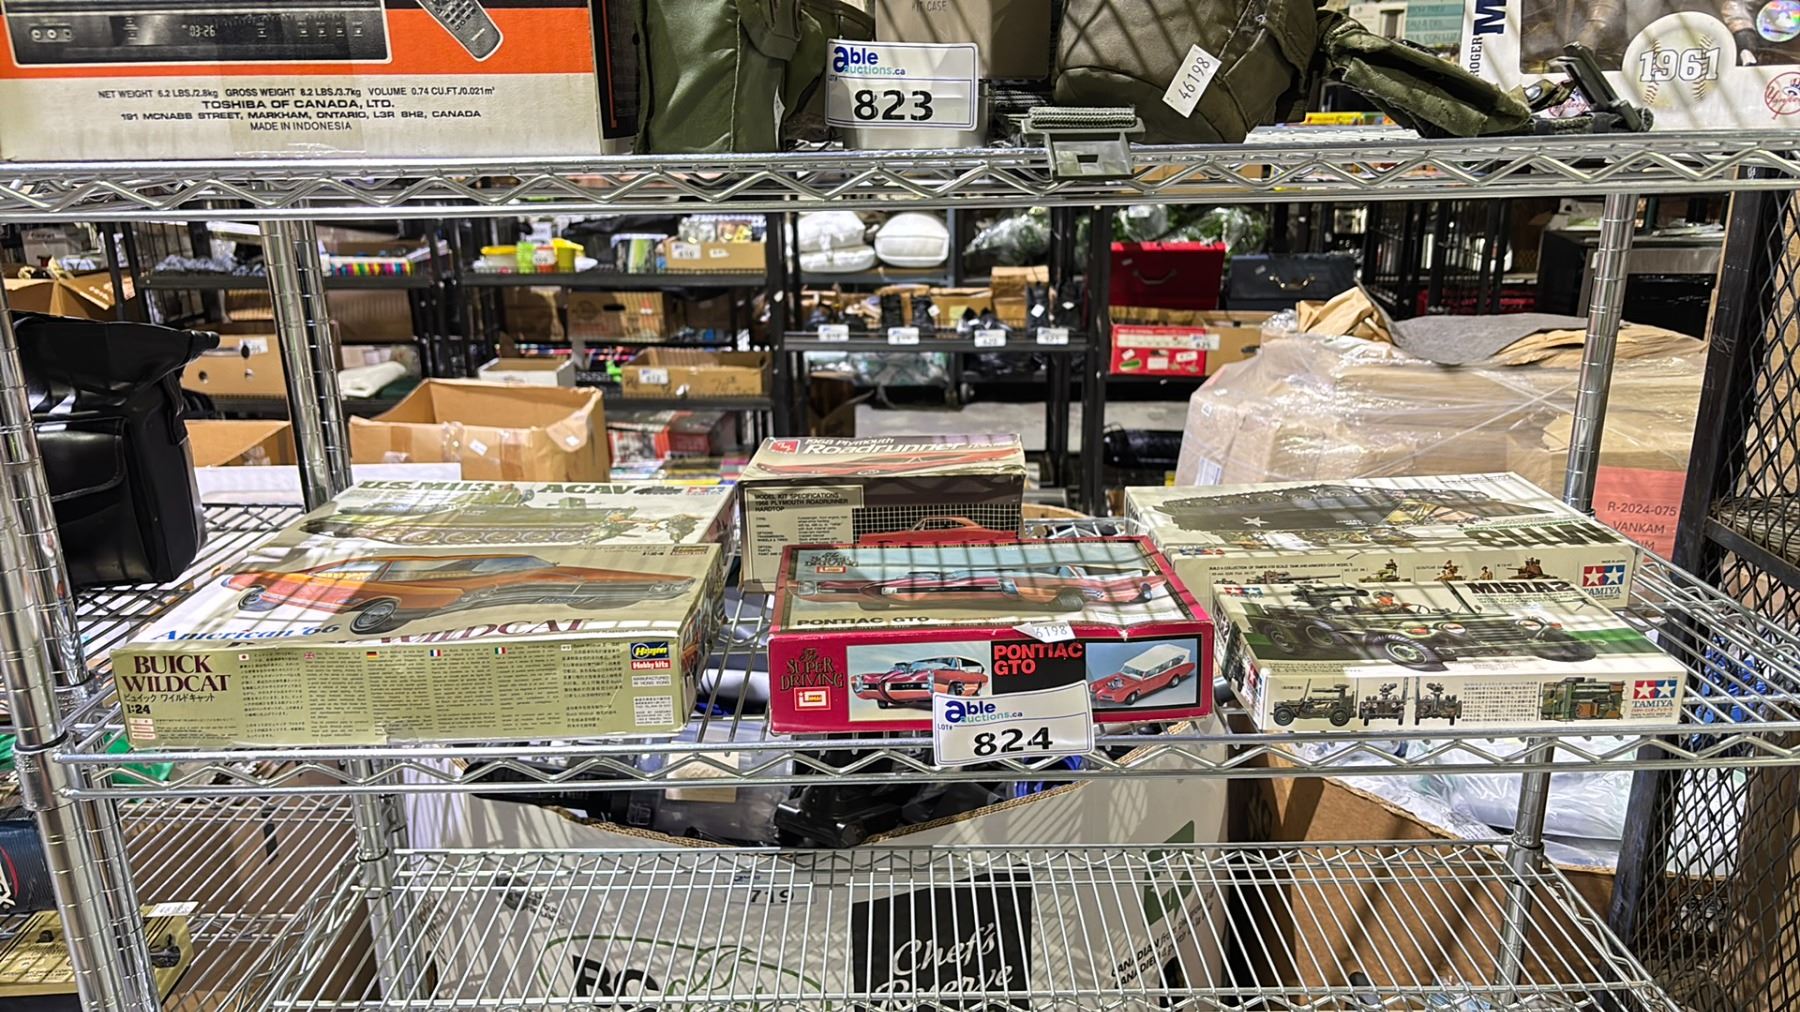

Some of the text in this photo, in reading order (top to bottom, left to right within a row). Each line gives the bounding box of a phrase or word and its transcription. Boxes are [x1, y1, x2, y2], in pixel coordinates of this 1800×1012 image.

[833, 46, 879, 73] able
[1640, 47, 1721, 82] 1961
[1178, 57, 1210, 99] 46198
[98, 90, 116, 99] NET
[119, 90, 154, 98] WEIGHT
[225, 88, 258, 97] GROSS
[260, 88, 296, 97] WEIGHT
[368, 87, 407, 96] VOLUME
[411, 87, 429, 96] 0.74
[202, 99, 395, 110] TOSHIBA OF CANADA, LTD.
[854, 89, 933, 121] 823
[121, 113, 139, 121] 191
[143, 112, 193, 121] MCNABB
[198, 112, 243, 121] STREET,
[248, 111, 312, 120] MARKHAM,
[316, 110, 369, 120] ONTARIO,
[373, 110, 395, 119] L3R
[432, 110, 481, 118] CANADA
[250, 122, 352, 131] MADE IN INDONESIA
[802, 443, 967, 455] Roadrunner
[537, 484, 638, 495] ACAV
[1607, 501, 1677, 517] R-2024-075
[1613, 521, 1665, 534] VANKAM
[1466, 581, 1573, 594] M151A2
[797, 617, 883, 626] PONTIAC
[152, 629, 294, 640] American
[994, 642, 1083, 660] PONTIAC
[134, 654, 213, 674] BUICK
[632, 660, 669, 670] Hobby kits
[787, 656, 834, 674] SUPER
[994, 659, 1036, 676] GTO
[121, 674, 231, 692] WILDCAT
[780, 672, 844, 692] DRIVING
[126, 704, 151, 714] 1:24
[945, 700, 996, 723] able
[973, 727, 1053, 756] 824
[751, 889, 794, 903] 719
[893, 922, 996, 976] Chef's
